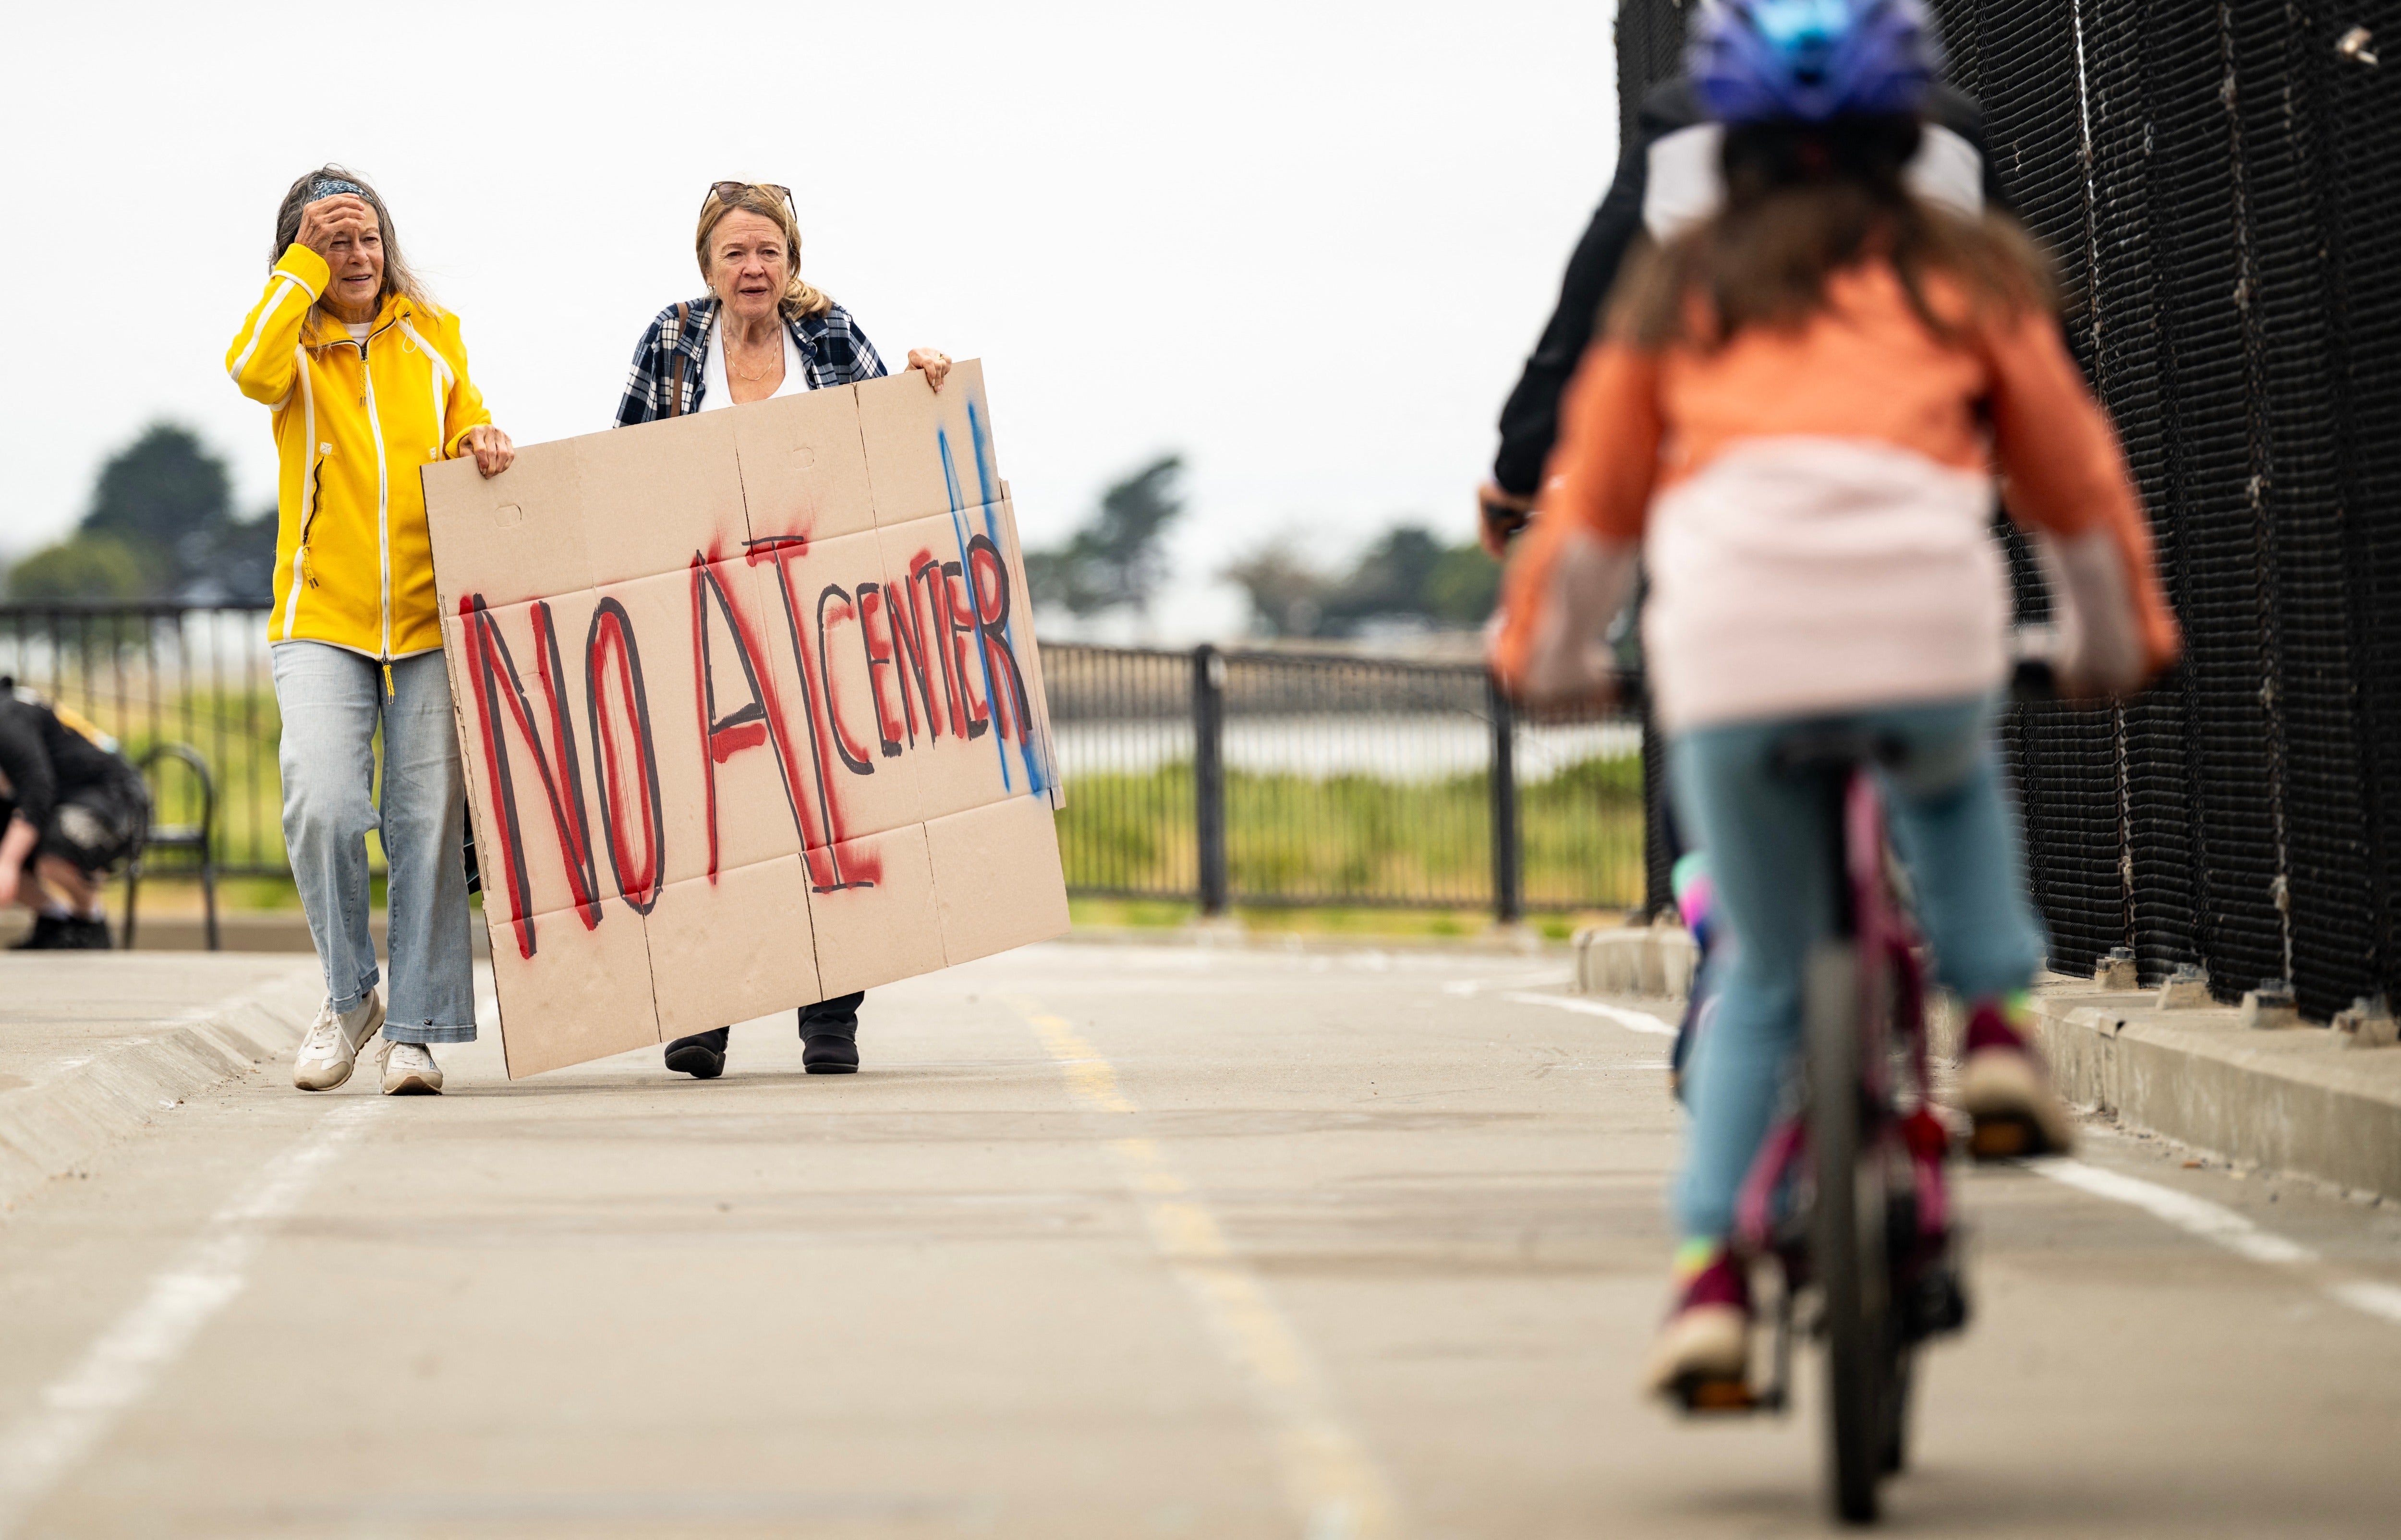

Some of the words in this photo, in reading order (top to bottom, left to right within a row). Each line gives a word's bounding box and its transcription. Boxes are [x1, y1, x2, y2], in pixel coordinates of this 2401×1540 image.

[460, 594, 666, 960] NO
[691, 534, 883, 894] AI
[818, 534, 1032, 775] CENTER
